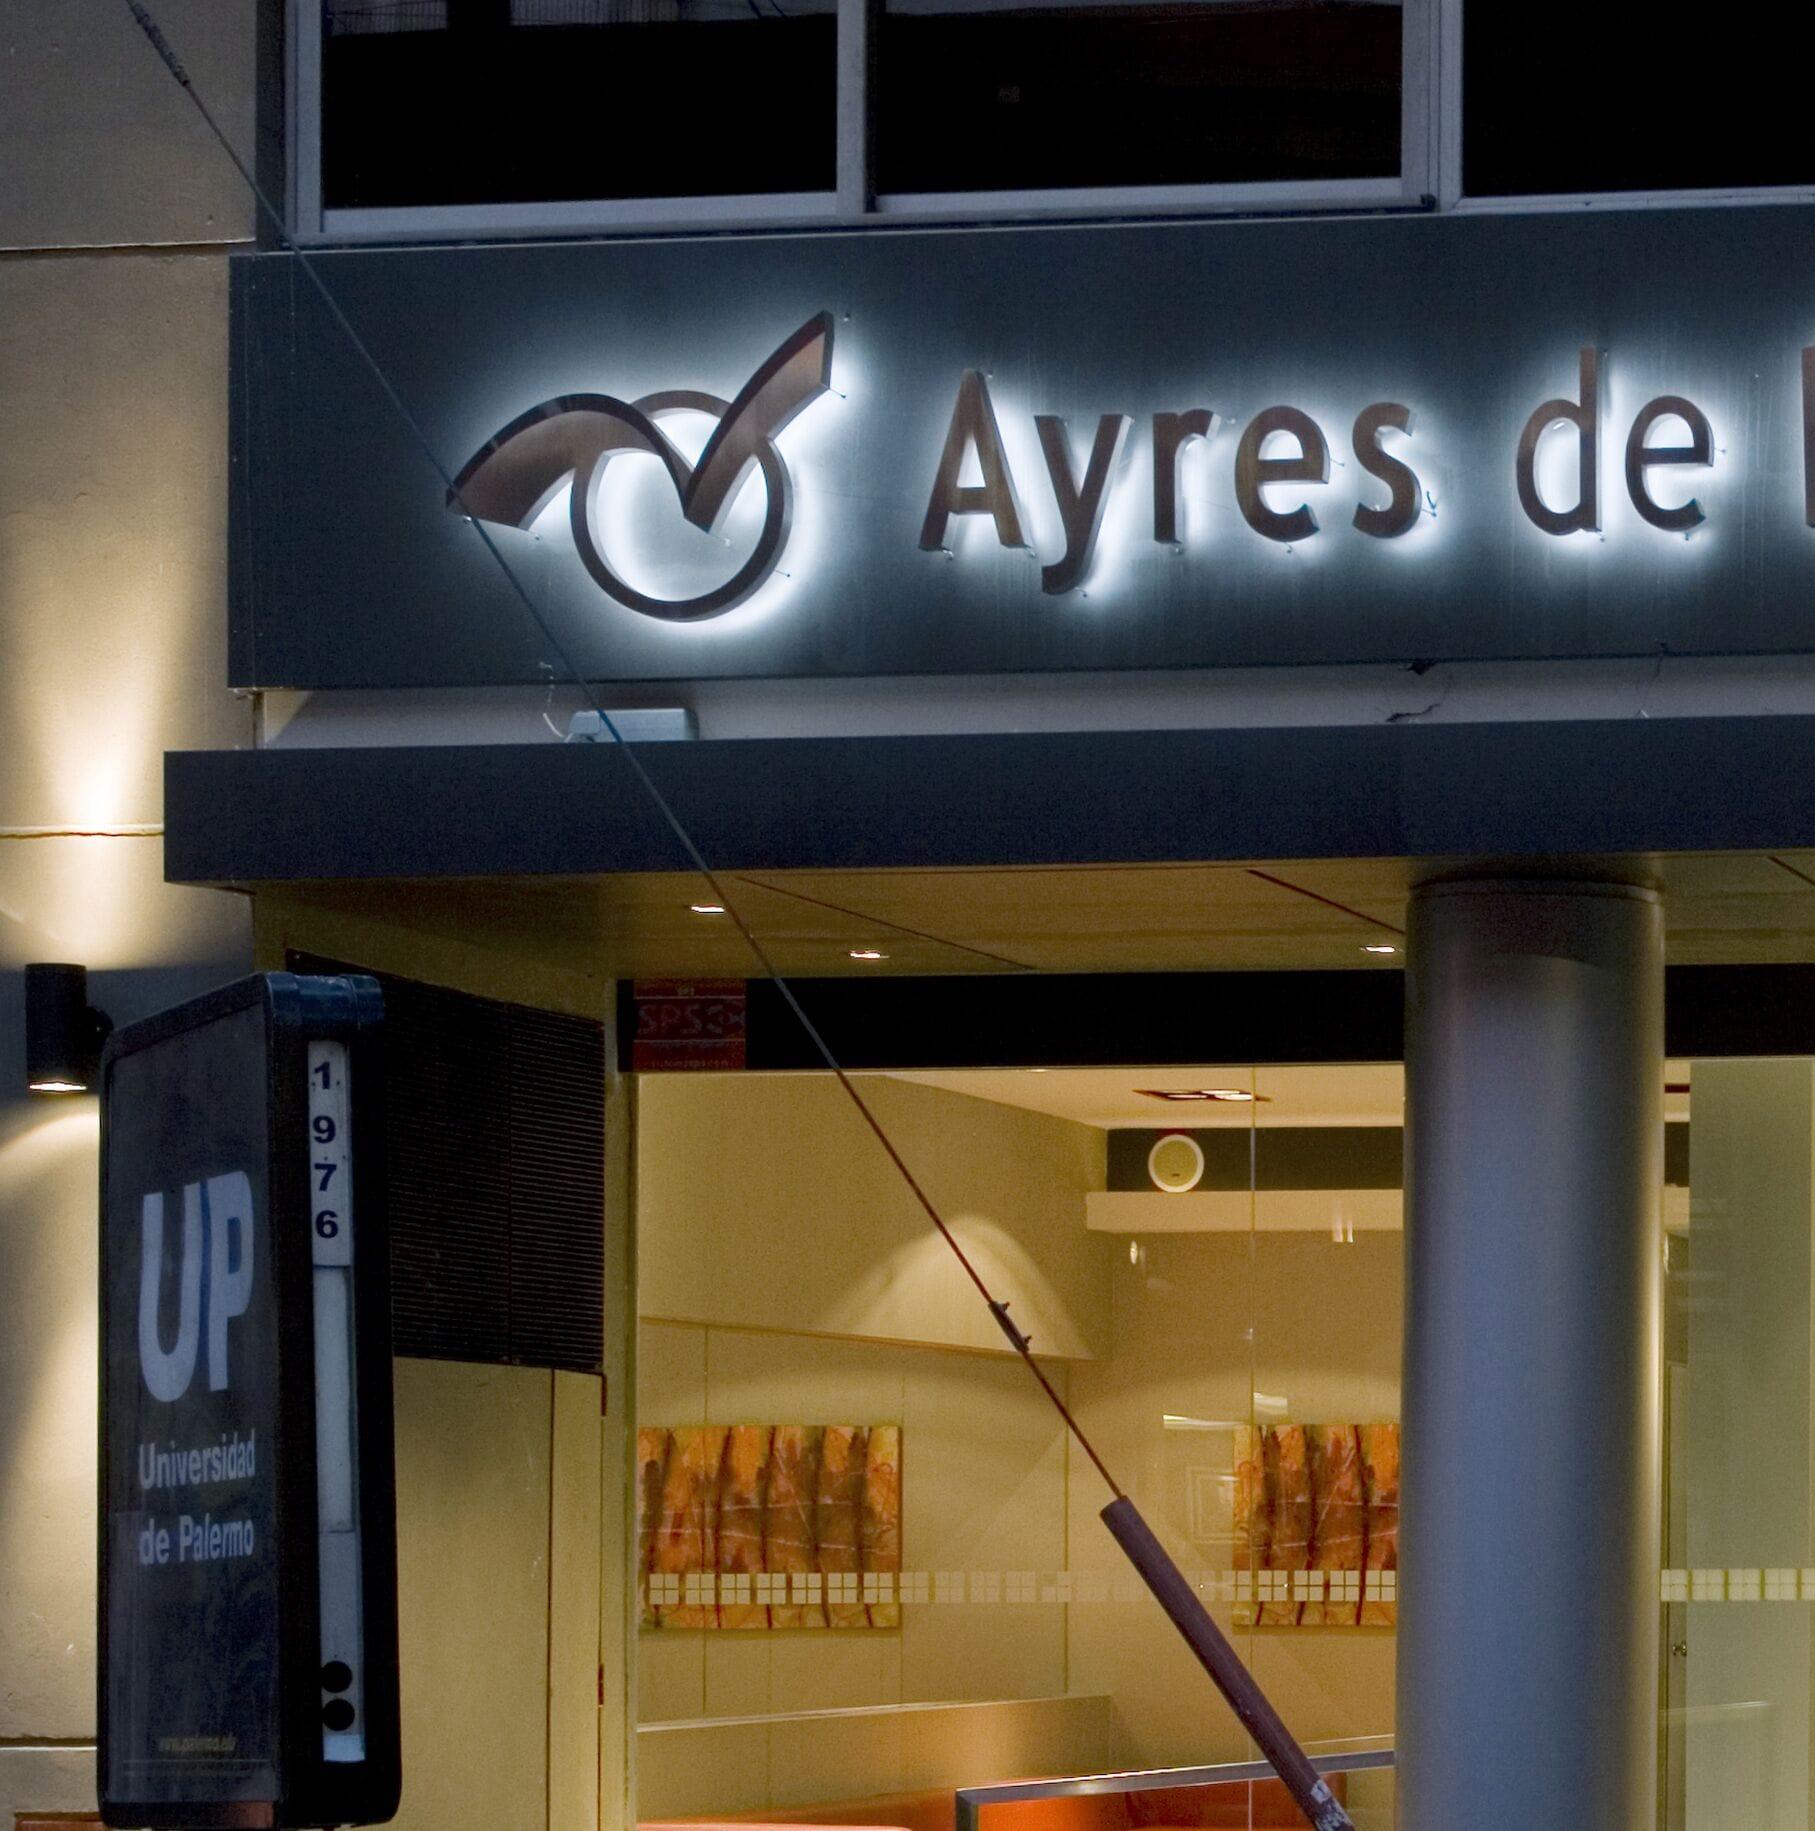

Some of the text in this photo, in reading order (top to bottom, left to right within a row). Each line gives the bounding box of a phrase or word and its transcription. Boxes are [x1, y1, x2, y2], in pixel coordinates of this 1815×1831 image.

[919, 368, 1426, 597] Ayres
[1514, 344, 1715, 538] de
[638, 1003, 702, 1034] SPS
[314, 1061, 339, 1239] 1976
[138, 1169, 254, 1403] UP
[139, 1428, 256, 1489] Universidad
[139, 1512, 254, 1566] de Palermo
